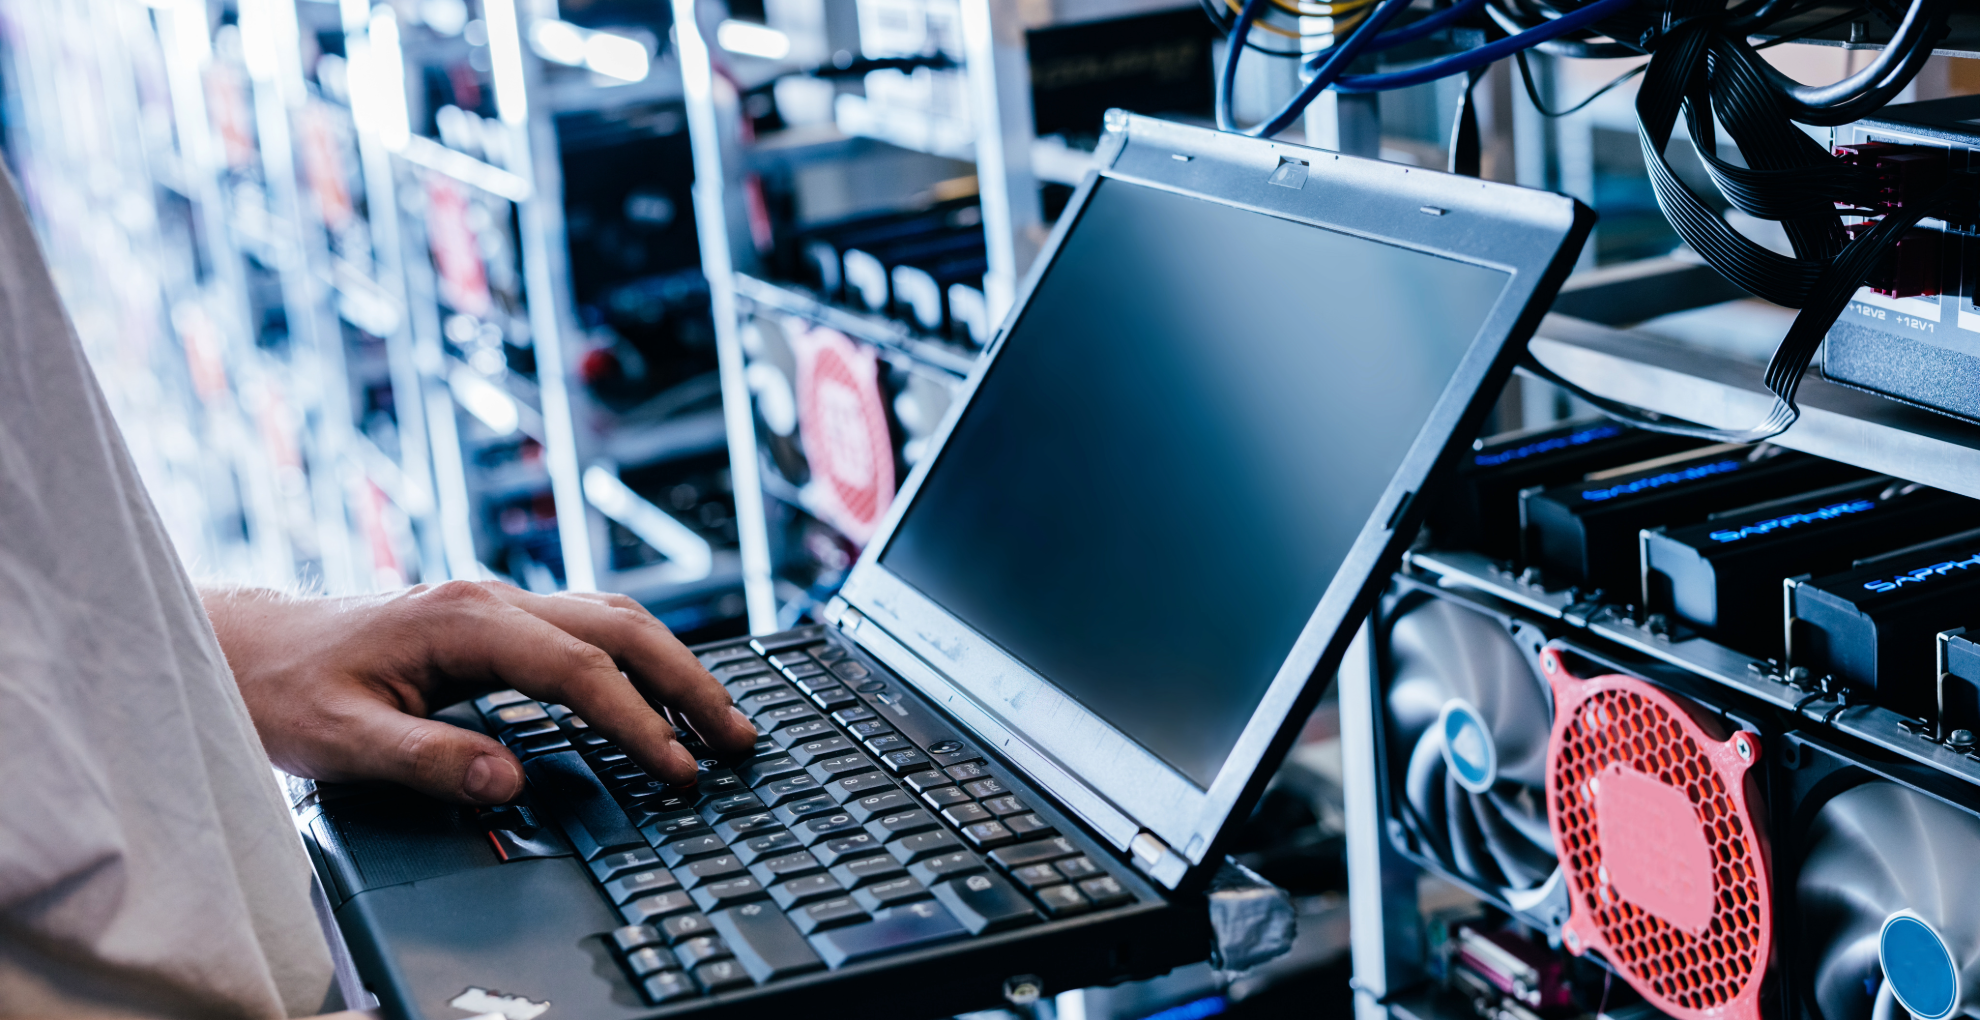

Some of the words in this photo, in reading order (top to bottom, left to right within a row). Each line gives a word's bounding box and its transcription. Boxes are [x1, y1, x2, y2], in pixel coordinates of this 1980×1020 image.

[1848, 303, 1886, 321] +12V2
[1896, 315, 1934, 333] +12V1
[904, 750, 916, 758] F8
[701, 759, 718, 767] G
[774, 759, 791, 767] Y
[716, 776, 735, 785] H
[792, 776, 811, 785] U
[662, 798, 681, 806] N
[678, 816, 698, 826] M
[750, 813, 770, 822] K
[830, 815, 849, 824] O
[769, 832, 786, 841] L
[849, 834, 868, 842] P
